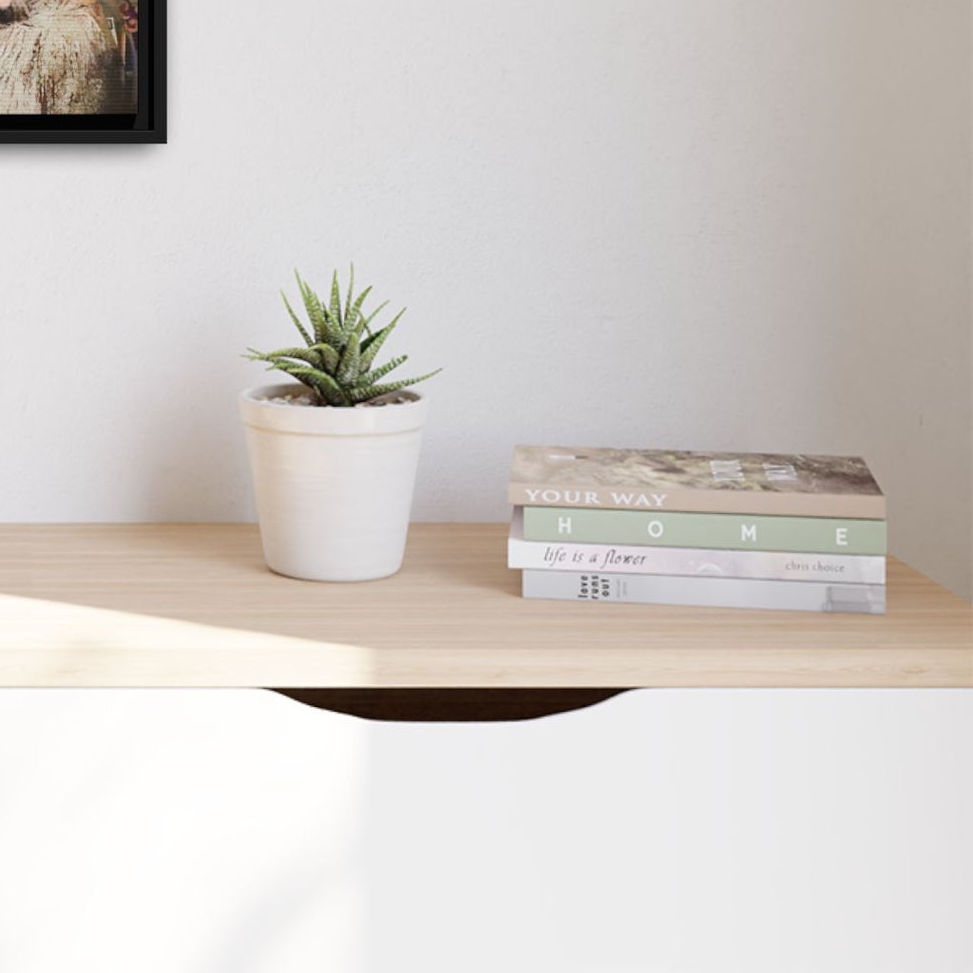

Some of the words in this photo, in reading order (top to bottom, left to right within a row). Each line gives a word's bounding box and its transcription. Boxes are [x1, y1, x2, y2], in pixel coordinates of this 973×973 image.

[526, 489, 600, 505] YOUR
[611, 492, 667, 507] WAY
[543, 546, 566, 567] life
[572, 550, 584, 563] is
[589, 554, 597, 564] a
[600, 548, 647, 569] flower
[785, 561, 809, 572] chris
[812, 561, 845, 574] choice
[578, 575, 588, 598] love
[601, 578, 610, 597] out
